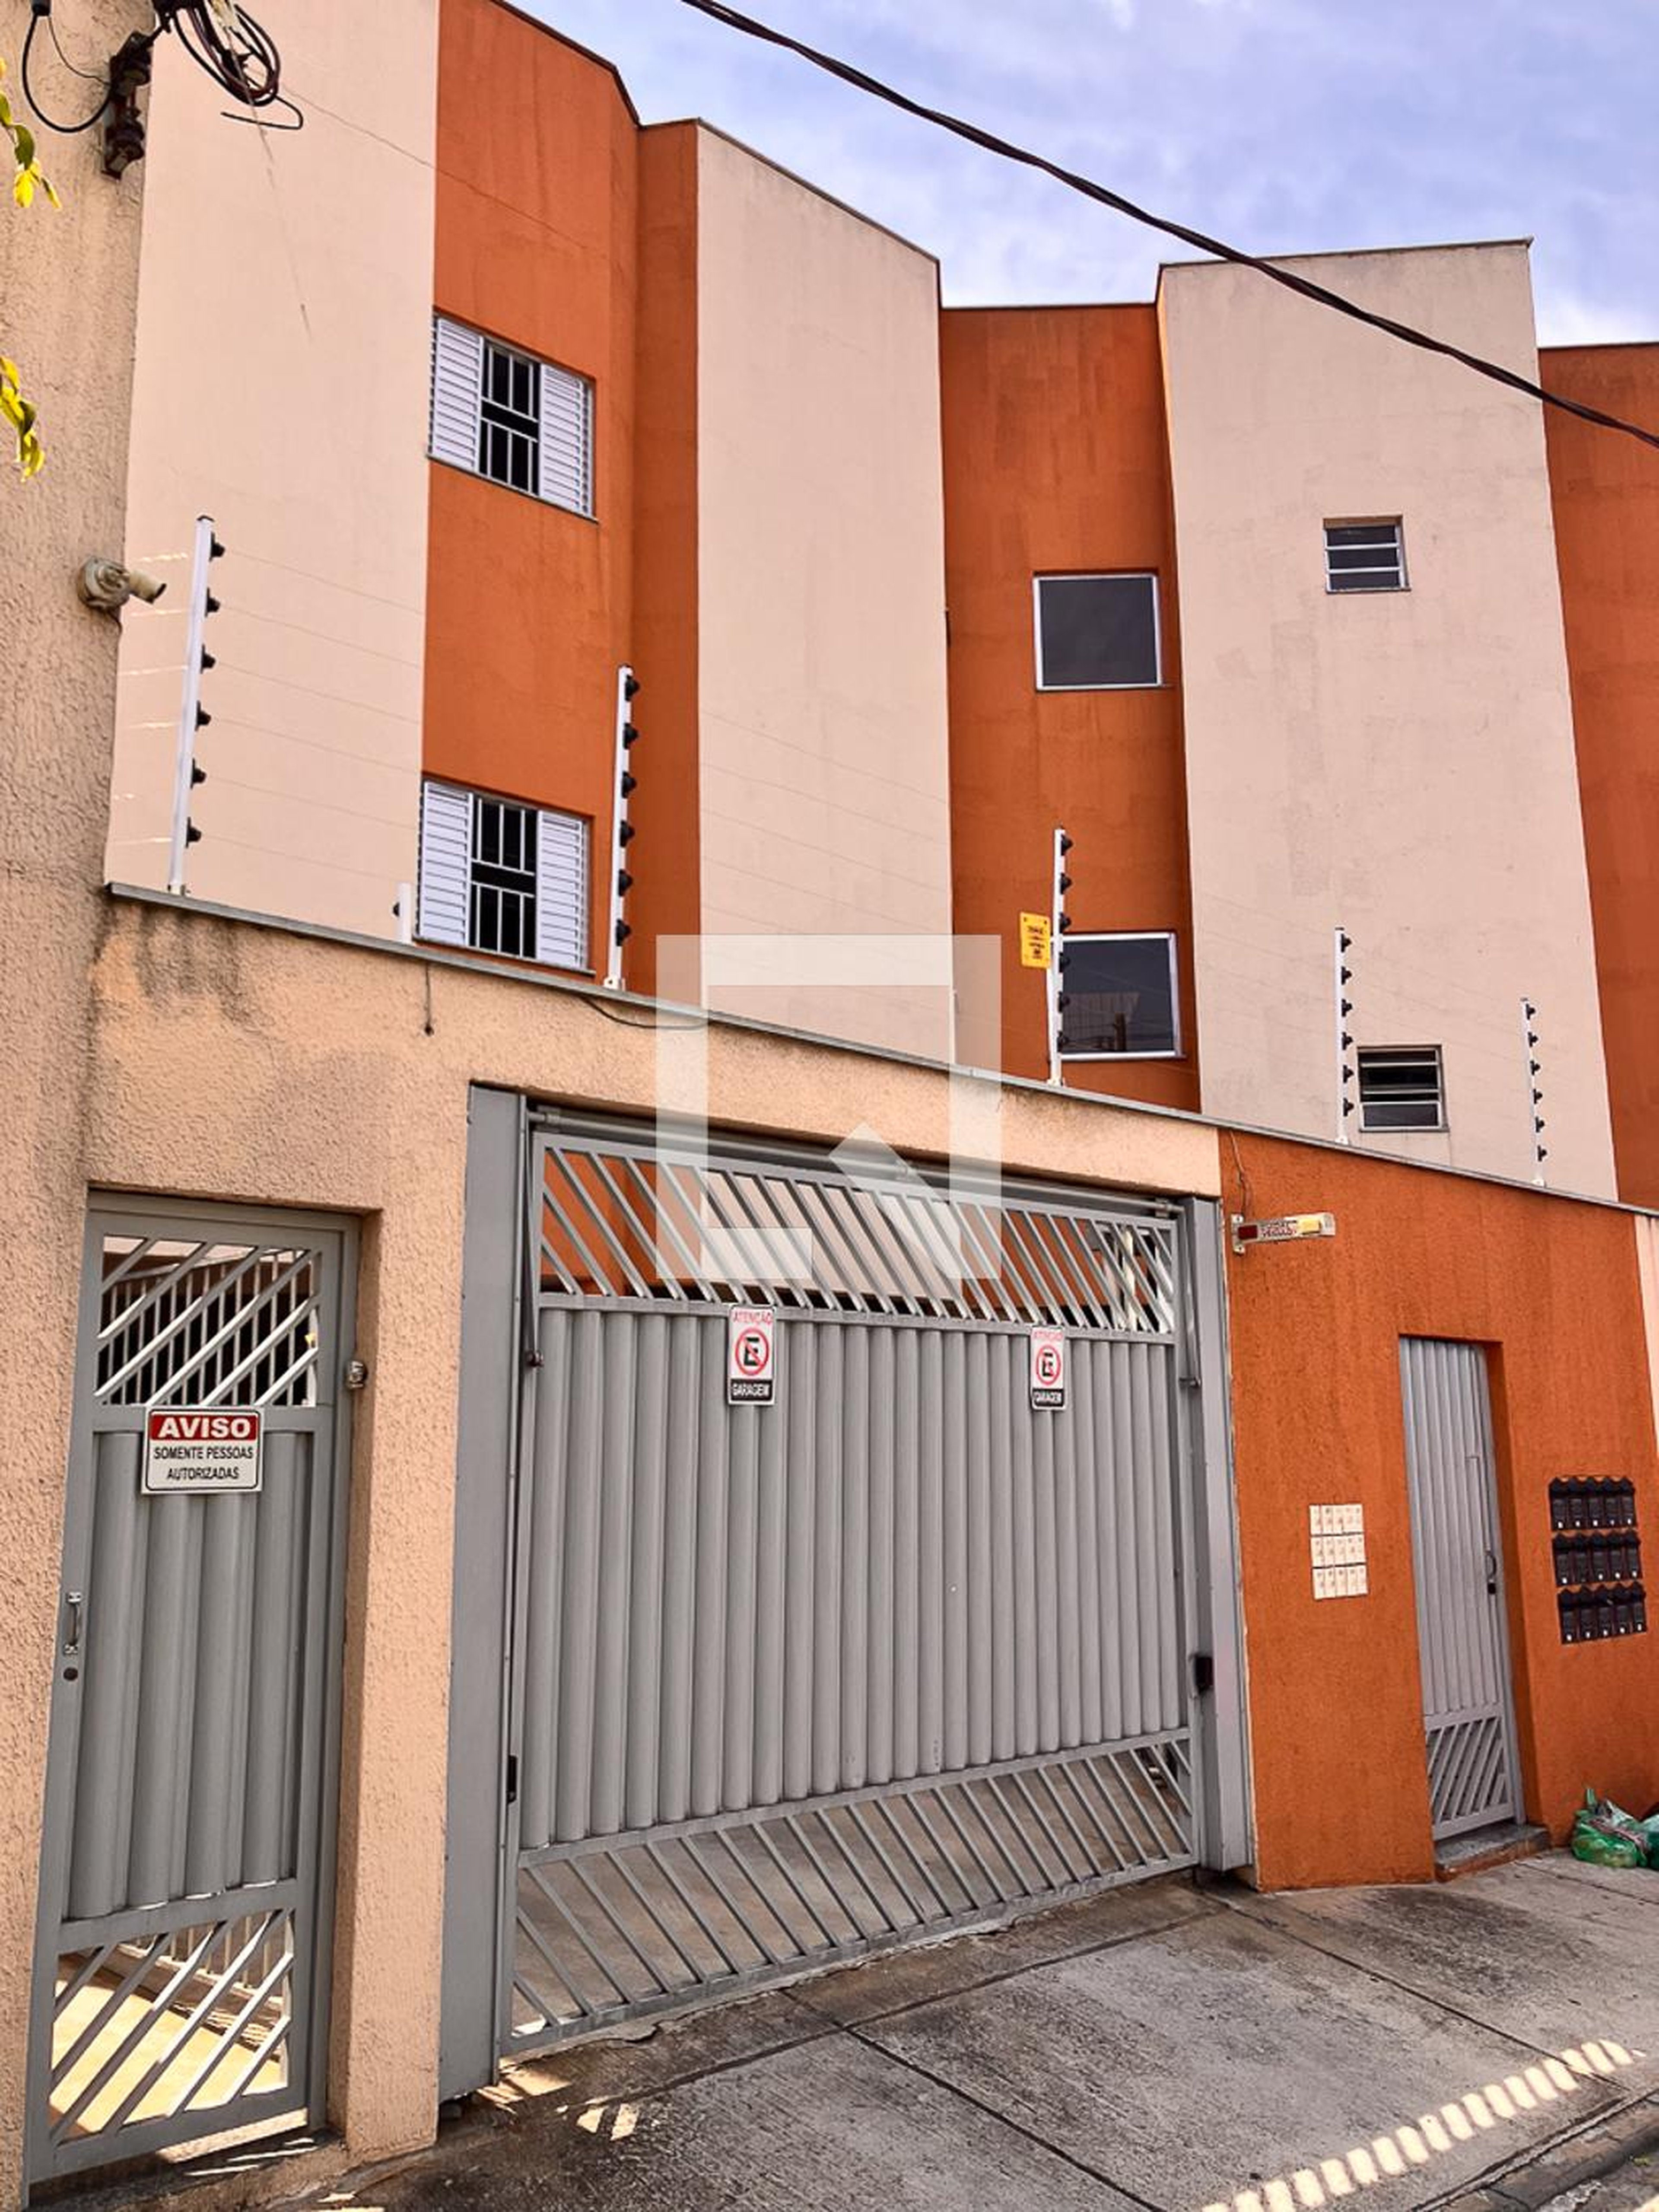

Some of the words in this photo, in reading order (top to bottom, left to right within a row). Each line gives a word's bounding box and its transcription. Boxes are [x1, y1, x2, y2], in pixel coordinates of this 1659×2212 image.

[158, 1417, 251, 1439] AVISO
[154, 1447, 203, 1459] SOMENTE
[207, 1446, 253, 1459] PESSOAS
[167, 1467, 240, 1480] AUTORIZADAS
